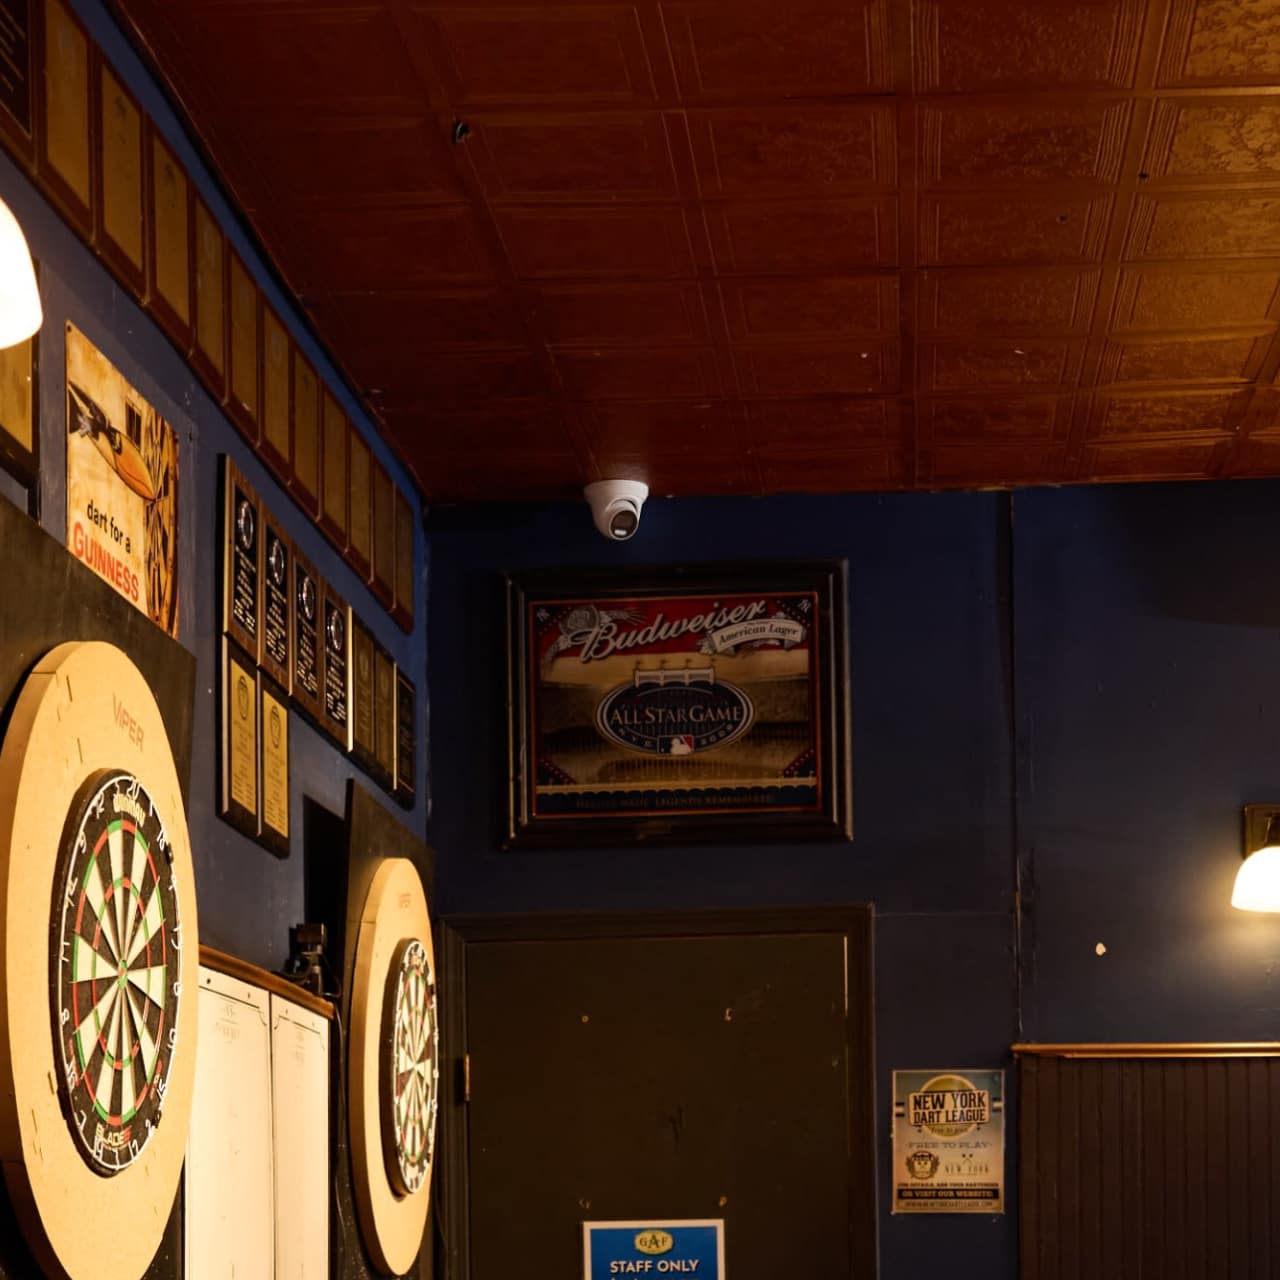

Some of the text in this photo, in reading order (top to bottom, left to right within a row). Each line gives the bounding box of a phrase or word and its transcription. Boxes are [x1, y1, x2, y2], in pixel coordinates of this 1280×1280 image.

[87, 499, 131, 554] dart for a
[73, 521, 139, 603] GUINNESS
[570, 599, 766, 663] Budweiser
[718, 622, 798, 645] American Lager
[113, 691, 144, 752] VIPER
[611, 704, 741, 725] ALL STAR GAME
[913, 1092, 987, 1110] NEW YORK
[914, 1109, 986, 1124] DART LEAGUE
[639, 1235, 668, 1249] GAF
[610, 1259, 700, 1273] STAFF ONLY
